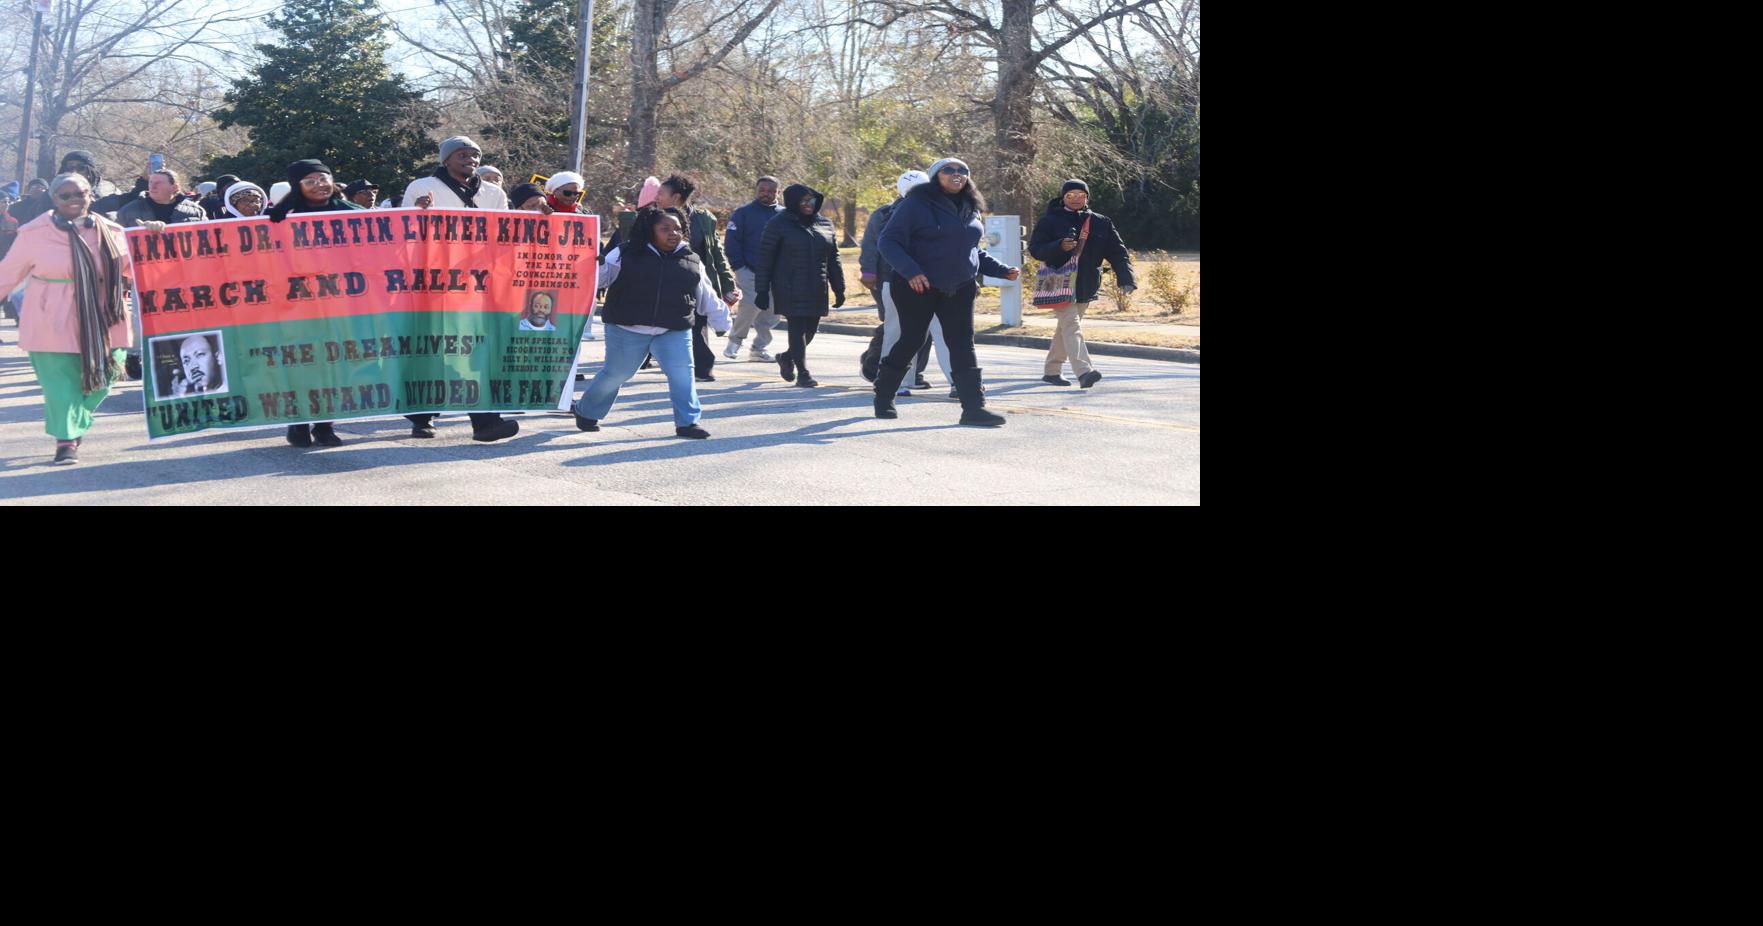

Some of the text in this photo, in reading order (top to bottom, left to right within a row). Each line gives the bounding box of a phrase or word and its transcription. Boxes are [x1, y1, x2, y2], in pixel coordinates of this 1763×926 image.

[238, 224, 281, 254] DR.
[291, 215, 393, 248] MARTIN
[401, 215, 488, 244] LUTHER
[497, 216, 549, 246] KING
[559, 220, 593, 248] JR.
[516, 270, 578, 280] COUNCILMAN
[525, 261, 572, 270] THE LATE
[287, 272, 366, 300] AND
[384, 268, 489, 293] RALLY
[512, 279, 525, 287] ED
[325, 335, 411, 363] DREAM
[258, 390, 299, 418] WE
[405, 379, 480, 408] DIVIDED
[490, 379, 512, 405] WE
